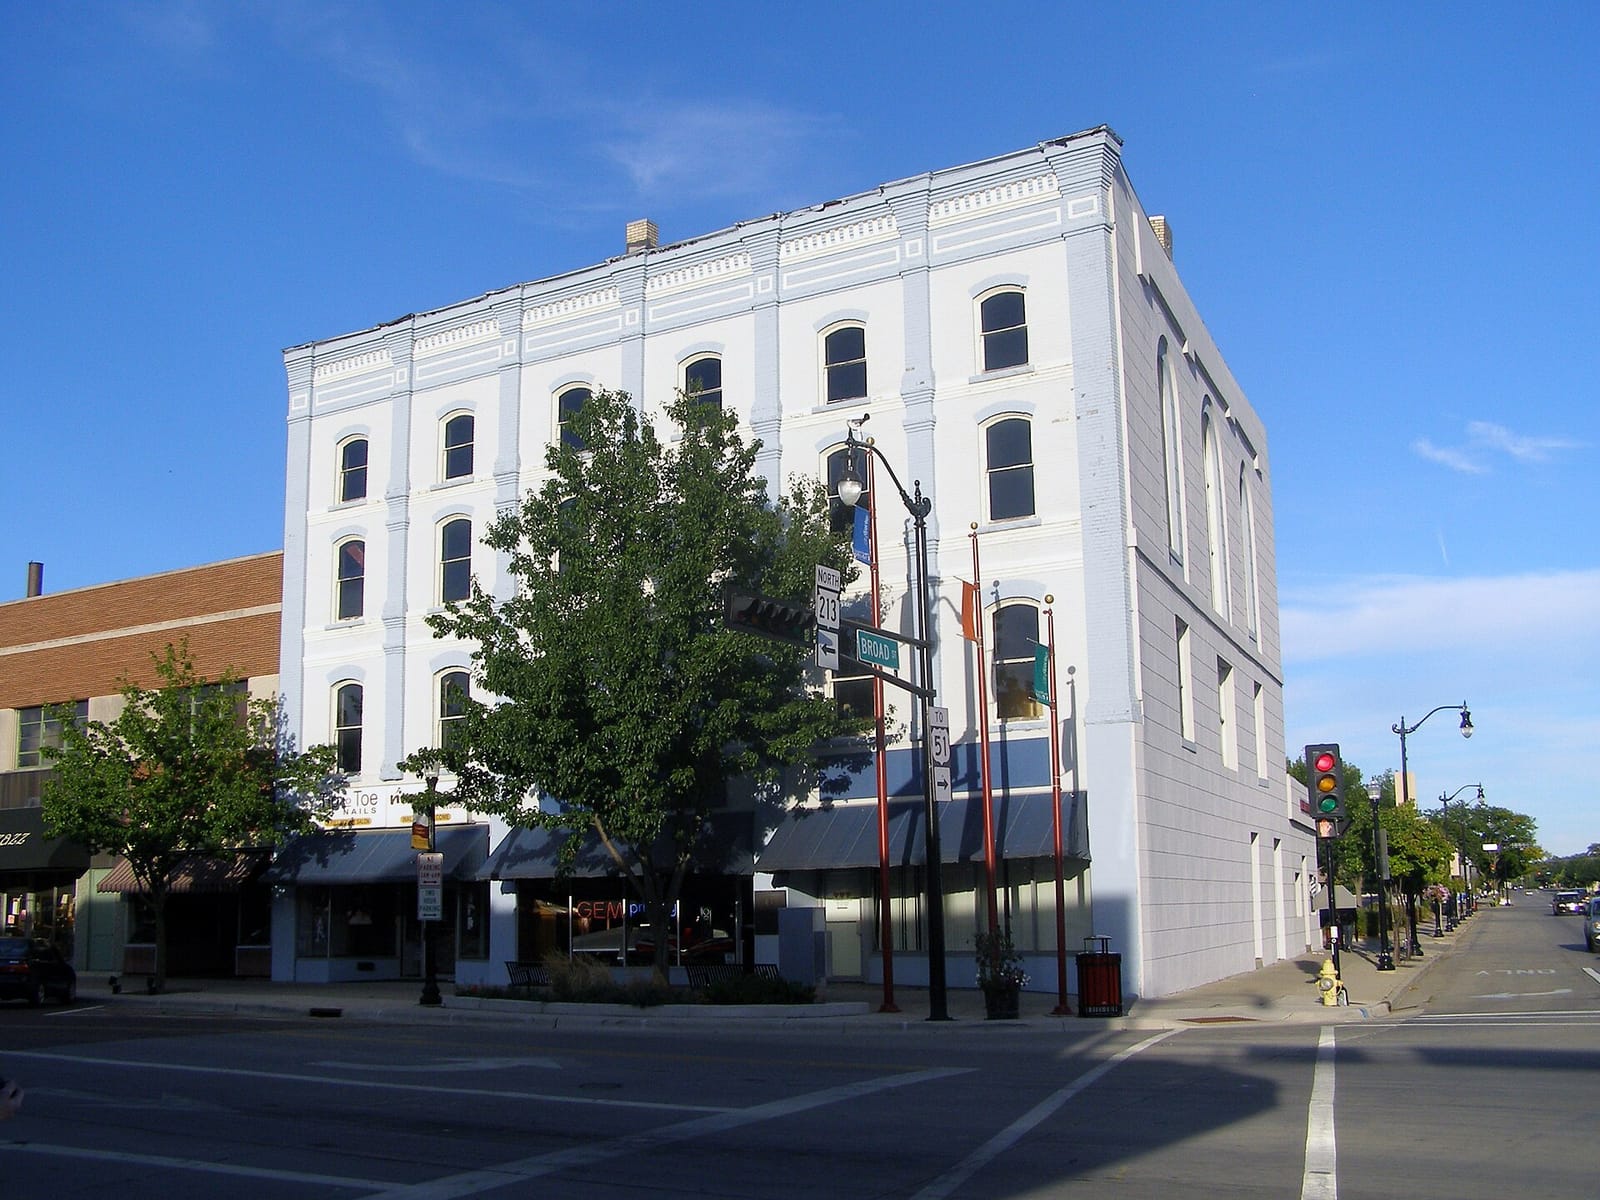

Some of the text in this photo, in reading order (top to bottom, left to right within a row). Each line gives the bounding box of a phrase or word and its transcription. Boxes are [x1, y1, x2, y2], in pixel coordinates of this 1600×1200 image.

[818, 569, 840, 587] NORTH
[820, 596, 836, 621] 213
[861, 637, 890, 660] BROAD
[935, 711, 944, 722] TO
[934, 735, 947, 756] 51
[354, 790, 378, 807] Toe
[343, 807, 377, 815] NAILS
[576, 901, 625, 919] GEM
